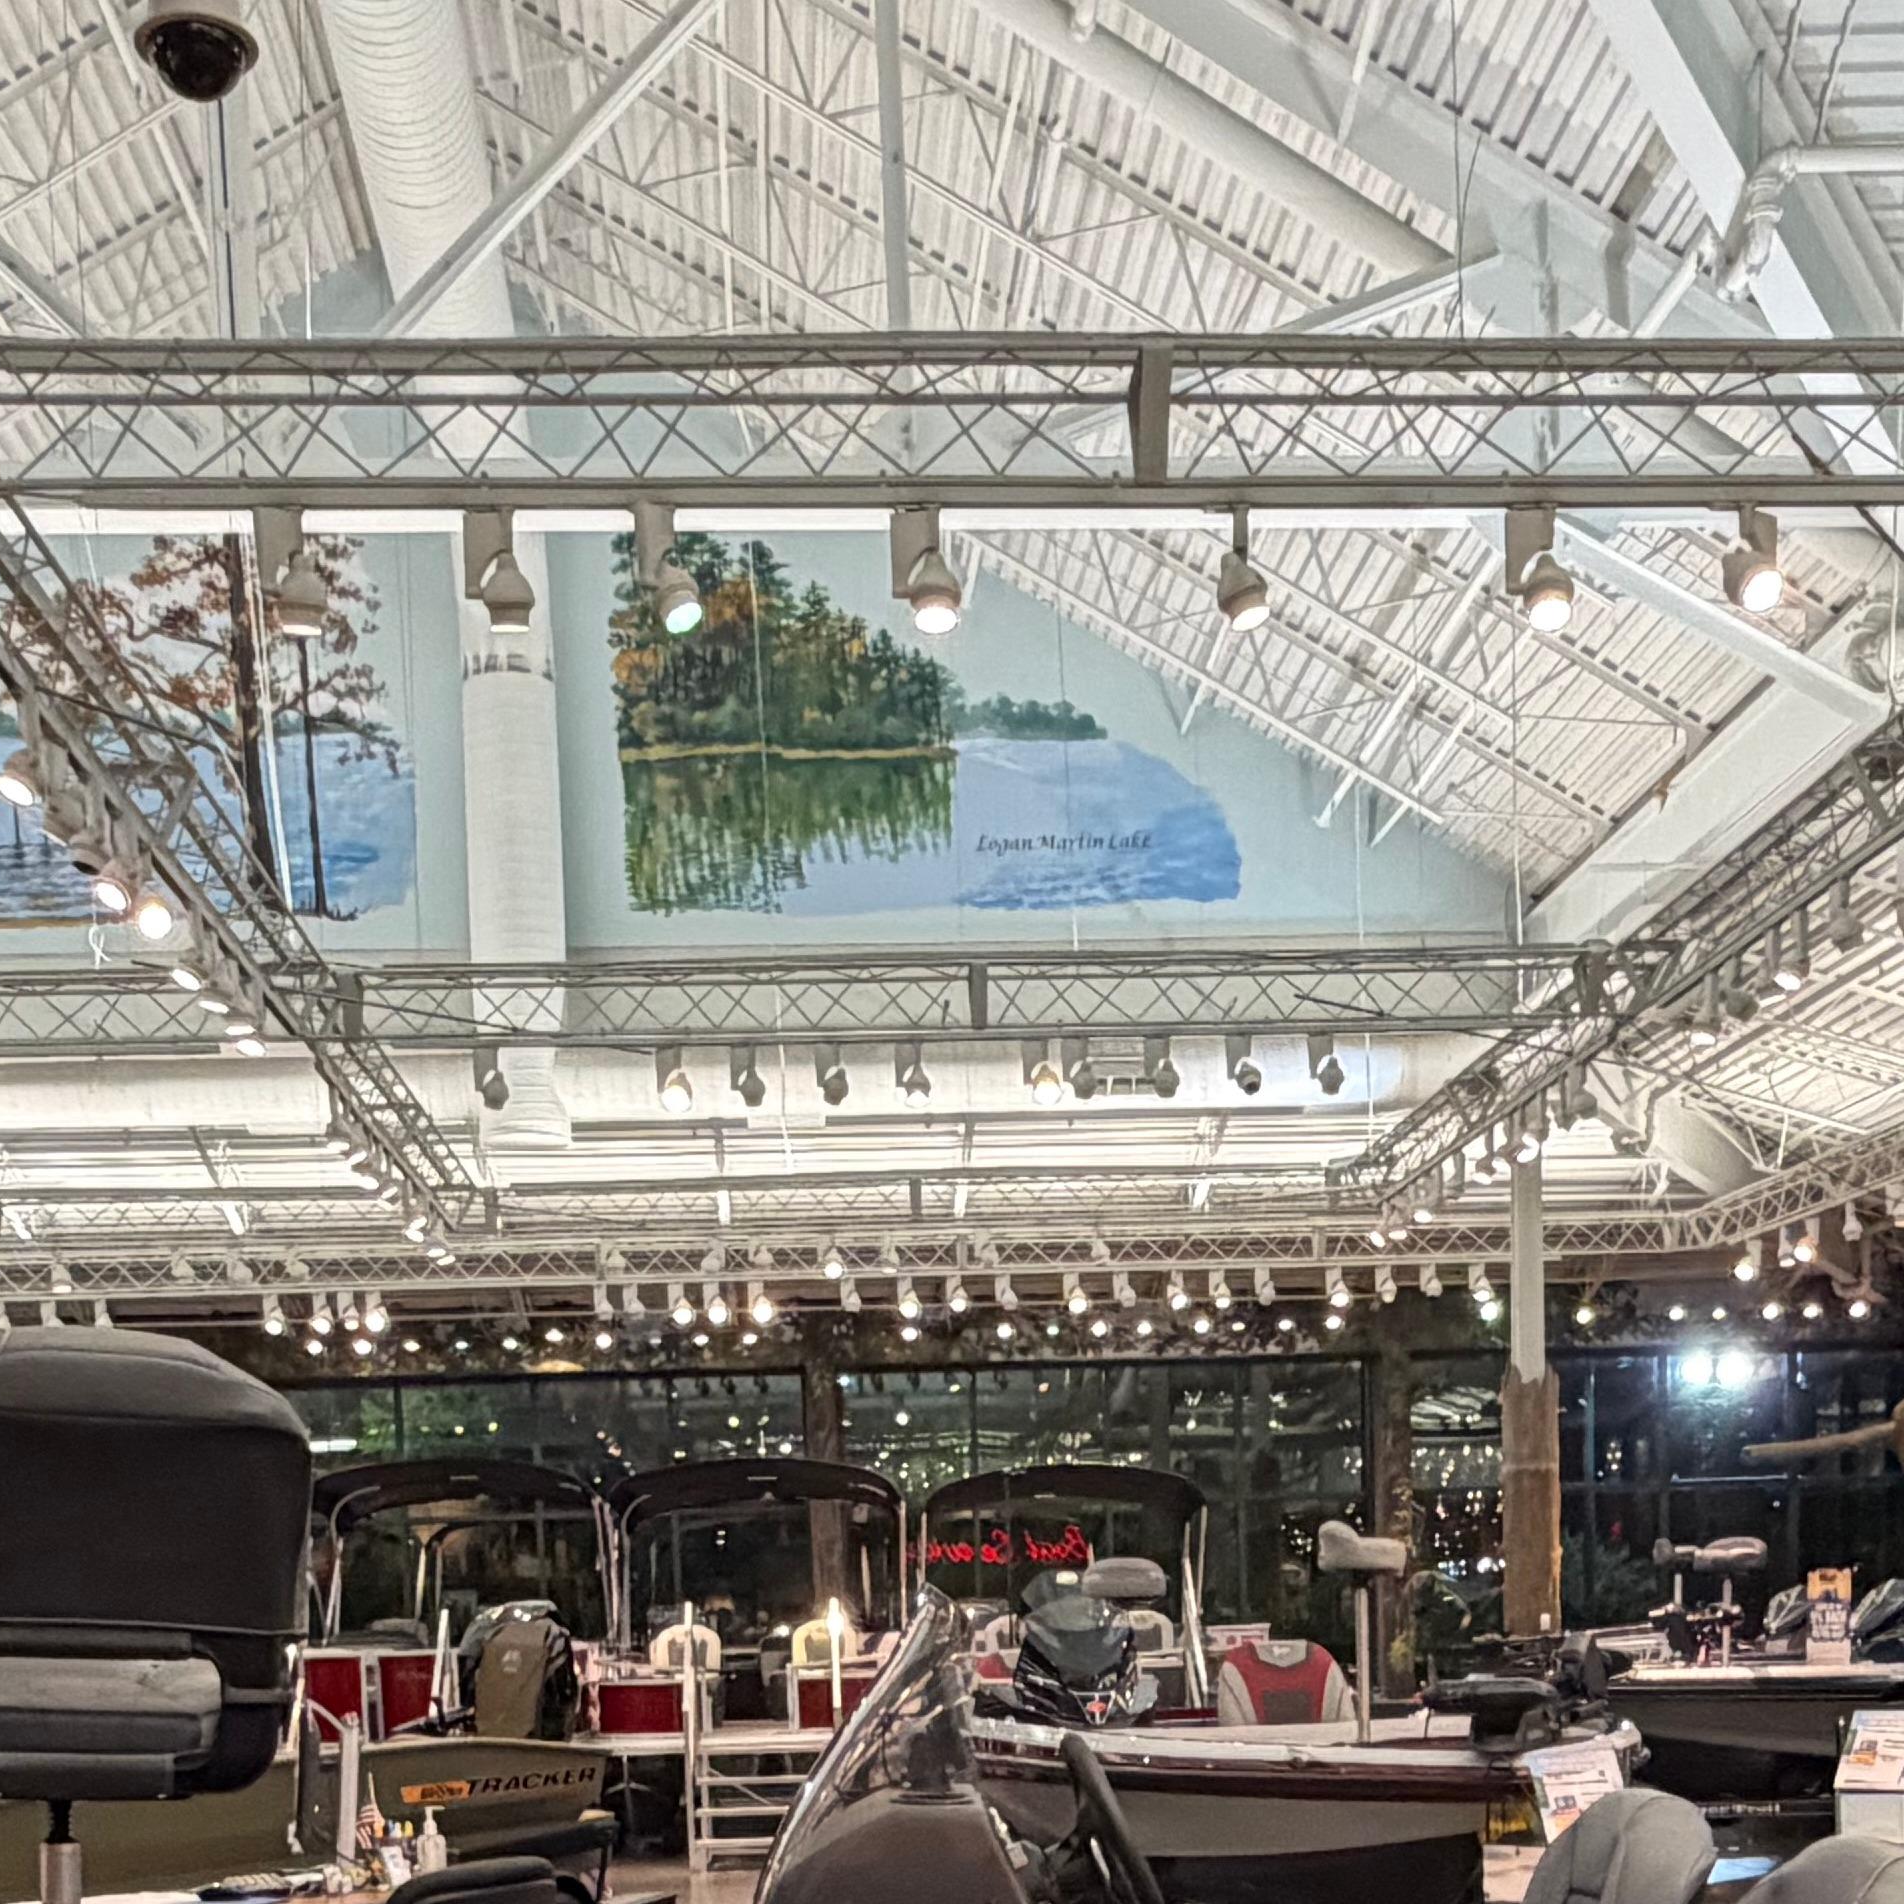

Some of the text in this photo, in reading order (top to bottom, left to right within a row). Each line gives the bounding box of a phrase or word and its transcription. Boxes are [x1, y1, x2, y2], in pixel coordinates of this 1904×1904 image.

[976, 829, 1153, 857] Logan Martin Lake
[466, 1767, 596, 1797] TRACKER
